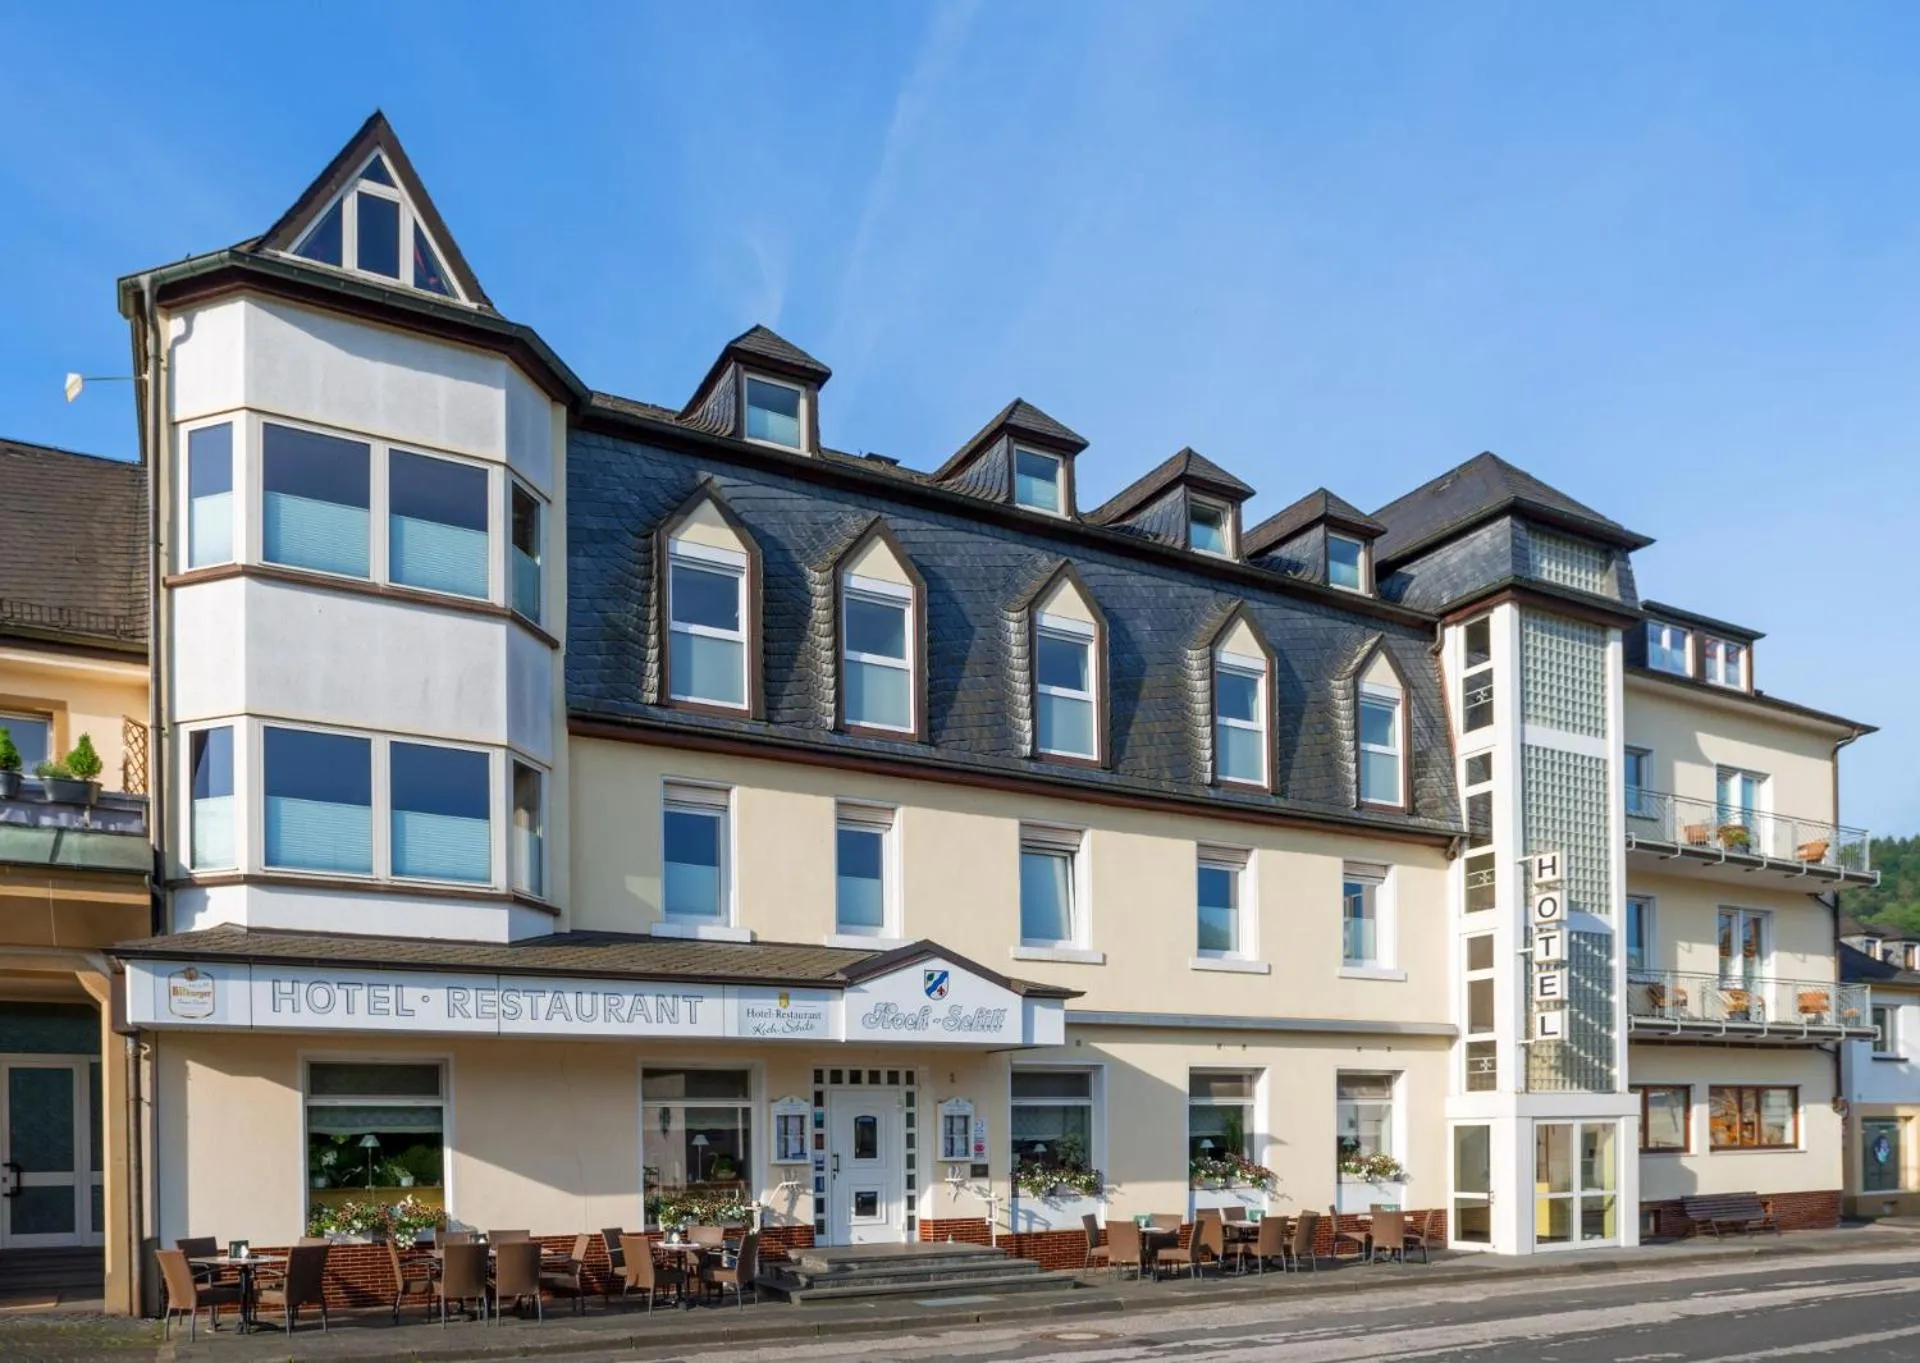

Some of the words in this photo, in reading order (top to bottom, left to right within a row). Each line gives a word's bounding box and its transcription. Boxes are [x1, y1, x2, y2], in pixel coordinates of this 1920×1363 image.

[272, 979, 416, 1018] HOTEL
[447, 987, 703, 1024] RESTAURANT
[1538, 855, 1558, 1036] HOTEL
